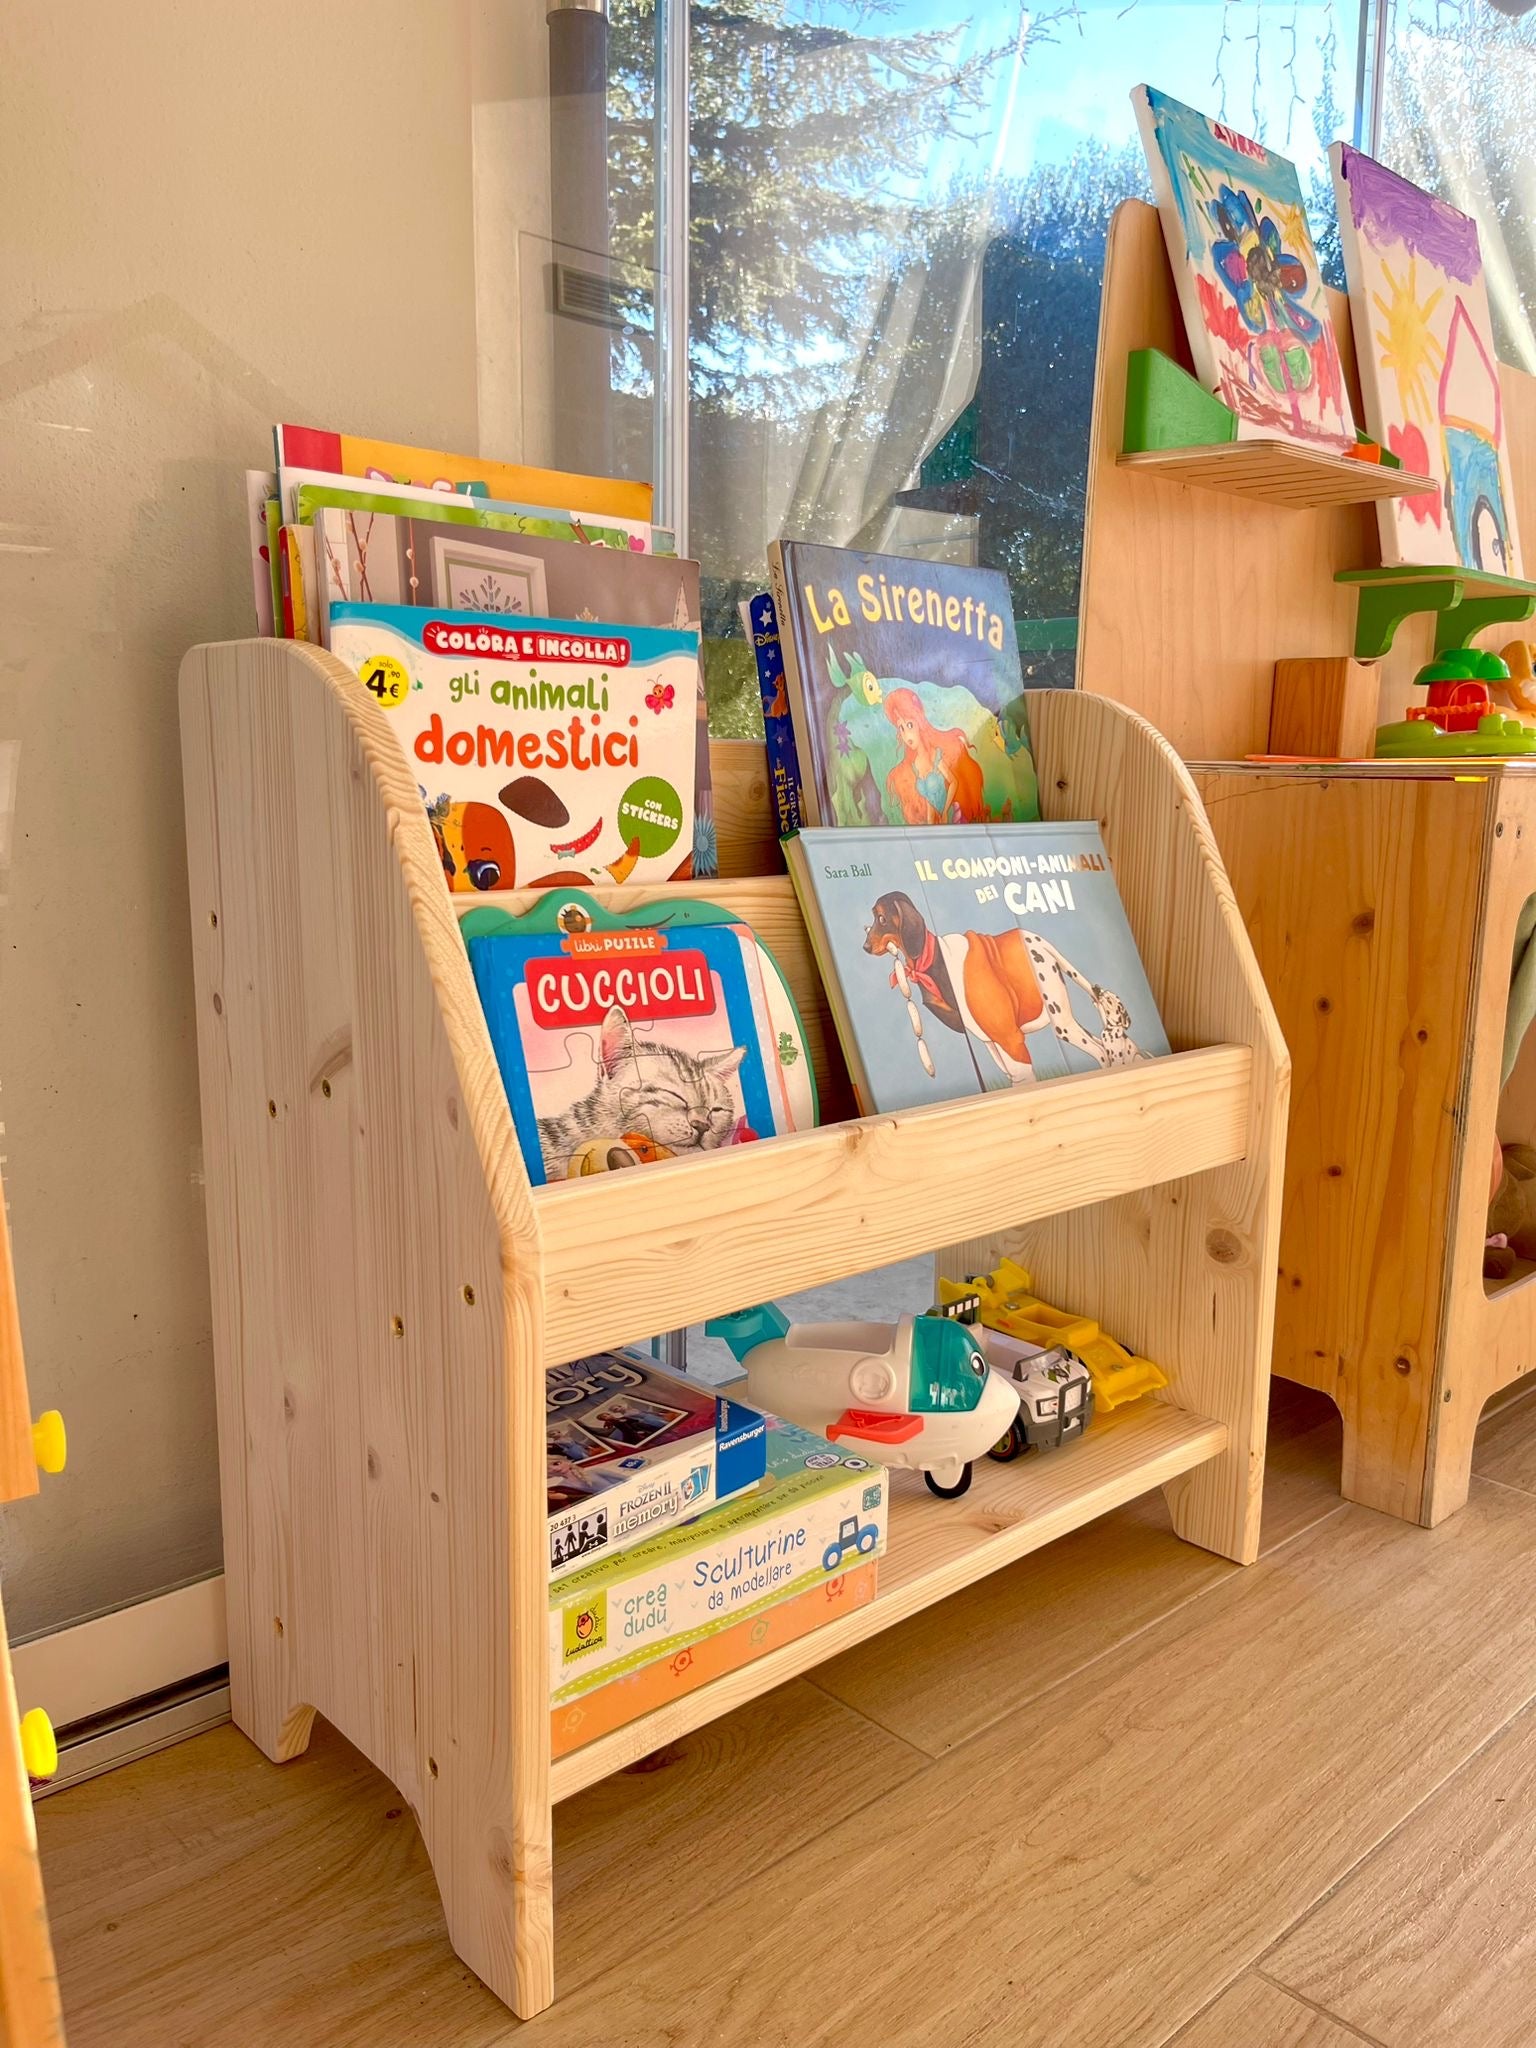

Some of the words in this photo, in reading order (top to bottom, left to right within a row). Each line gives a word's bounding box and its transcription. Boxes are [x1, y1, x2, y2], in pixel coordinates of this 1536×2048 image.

[804, 584, 851, 634] La
[857, 573, 1004, 650] Sirenetta
[436, 631, 518, 654] COLORA
[522, 637, 533, 655] E
[538, 638, 626, 661] INCOLLA!
[449, 669, 480, 703] gli
[490, 668, 609, 712] animali
[414, 713, 639, 771] domestici
[622, 802, 678, 830] STICKERS
[645, 799, 662, 811] CON
[774, 766, 790, 833] Fiabe
[824, 866, 849, 880] Sara
[852, 863, 872, 878] Ball
[915, 860, 939, 882] IL
[942, 854, 1106, 880] COMPONI-ANIMALI
[975, 884, 999, 904] DEI
[1003, 879, 1076, 915] CANI
[574, 940, 603, 953] libri
[604, 936, 655, 951] PUZZLE
[537, 965, 705, 1013] CUCCIOLI
[546, 1363, 643, 1413] ory
[719, 1424, 765, 1451] Ravensburger
[613, 1495, 679, 1538] memory
[620, 1486, 662, 1517] FROZEN
[664, 1481, 672, 1496] II
[571, 1563, 609, 1584] creativo
[693, 1528, 806, 1587] Sculturine
[624, 1583, 667, 1615] crea
[708, 1590, 723, 1610] da
[731, 1562, 792, 1599] modellare
